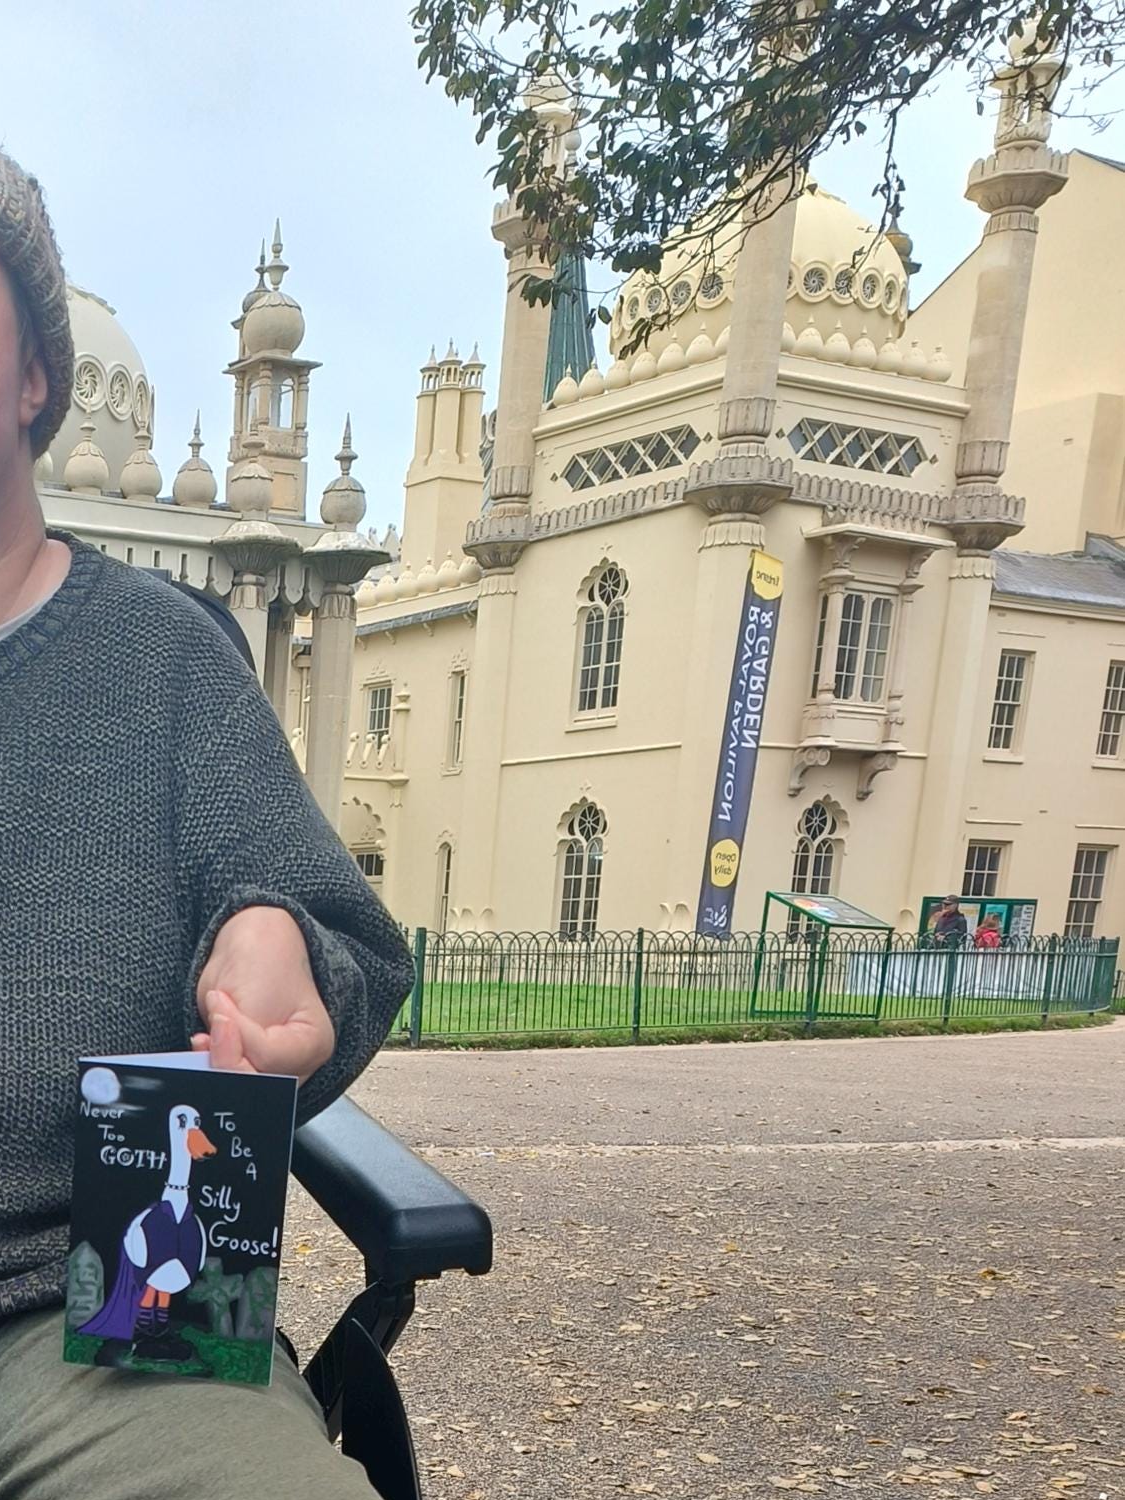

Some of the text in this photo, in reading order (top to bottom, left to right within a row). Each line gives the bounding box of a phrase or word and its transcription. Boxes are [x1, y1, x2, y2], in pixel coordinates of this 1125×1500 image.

[79, 1100, 126, 1119] Never
[97, 1123, 126, 1142] Too
[213, 1111, 236, 1132] To
[100, 1144, 168, 1170] GOTH
[230, 1136, 253, 1159] Be
[245, 1162, 257, 1181] A
[198, 1185, 242, 1223] Silly
[208, 1221, 279, 1259] Goose!
